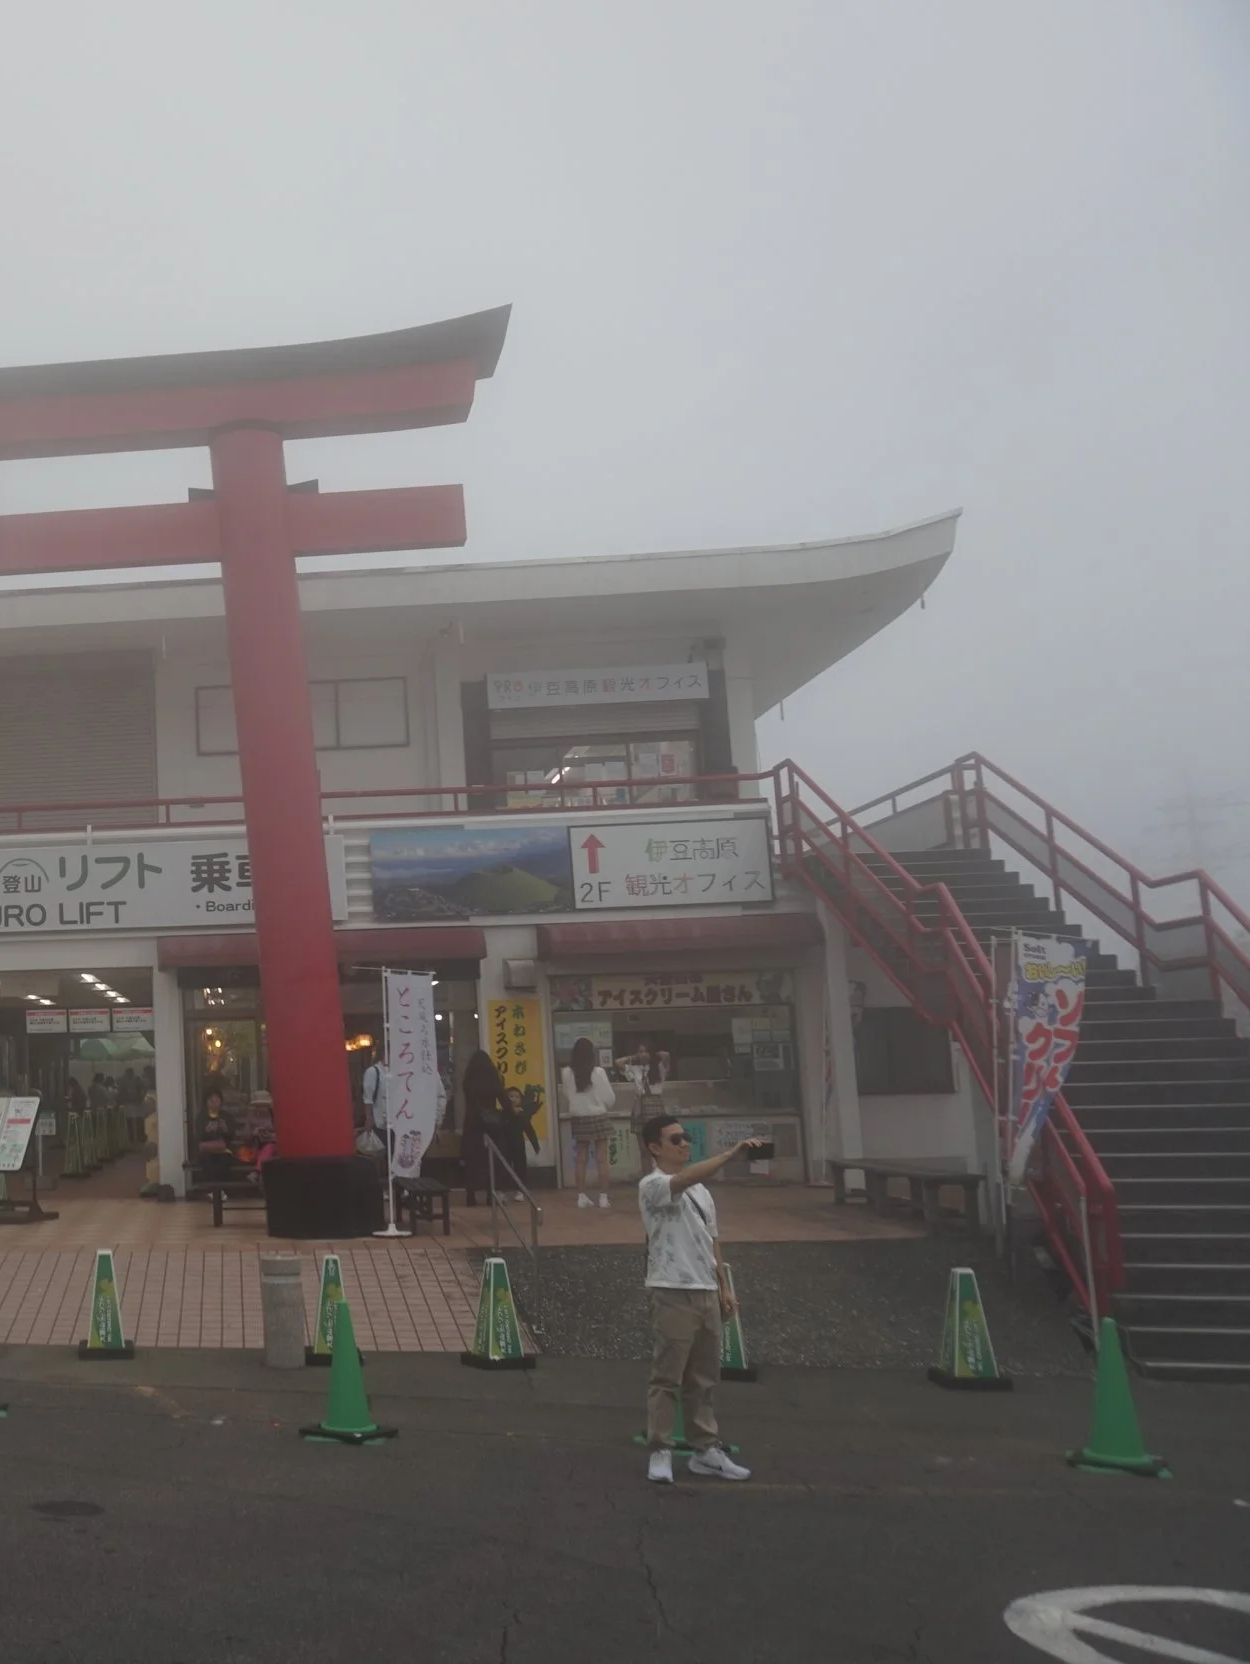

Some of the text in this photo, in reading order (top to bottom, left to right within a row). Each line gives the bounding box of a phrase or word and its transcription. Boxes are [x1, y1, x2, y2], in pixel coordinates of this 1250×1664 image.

[644, 836, 740, 863] 伊豆高原
[58, 851, 163, 892] リフト
[625, 869, 766, 897] 観光オフィス
[580, 880, 612, 904] 2F
[58, 900, 128, 925] LIFT
[395, 986, 415, 1120] ところてん
[494, 1004, 509, 1089] アイスクリー
